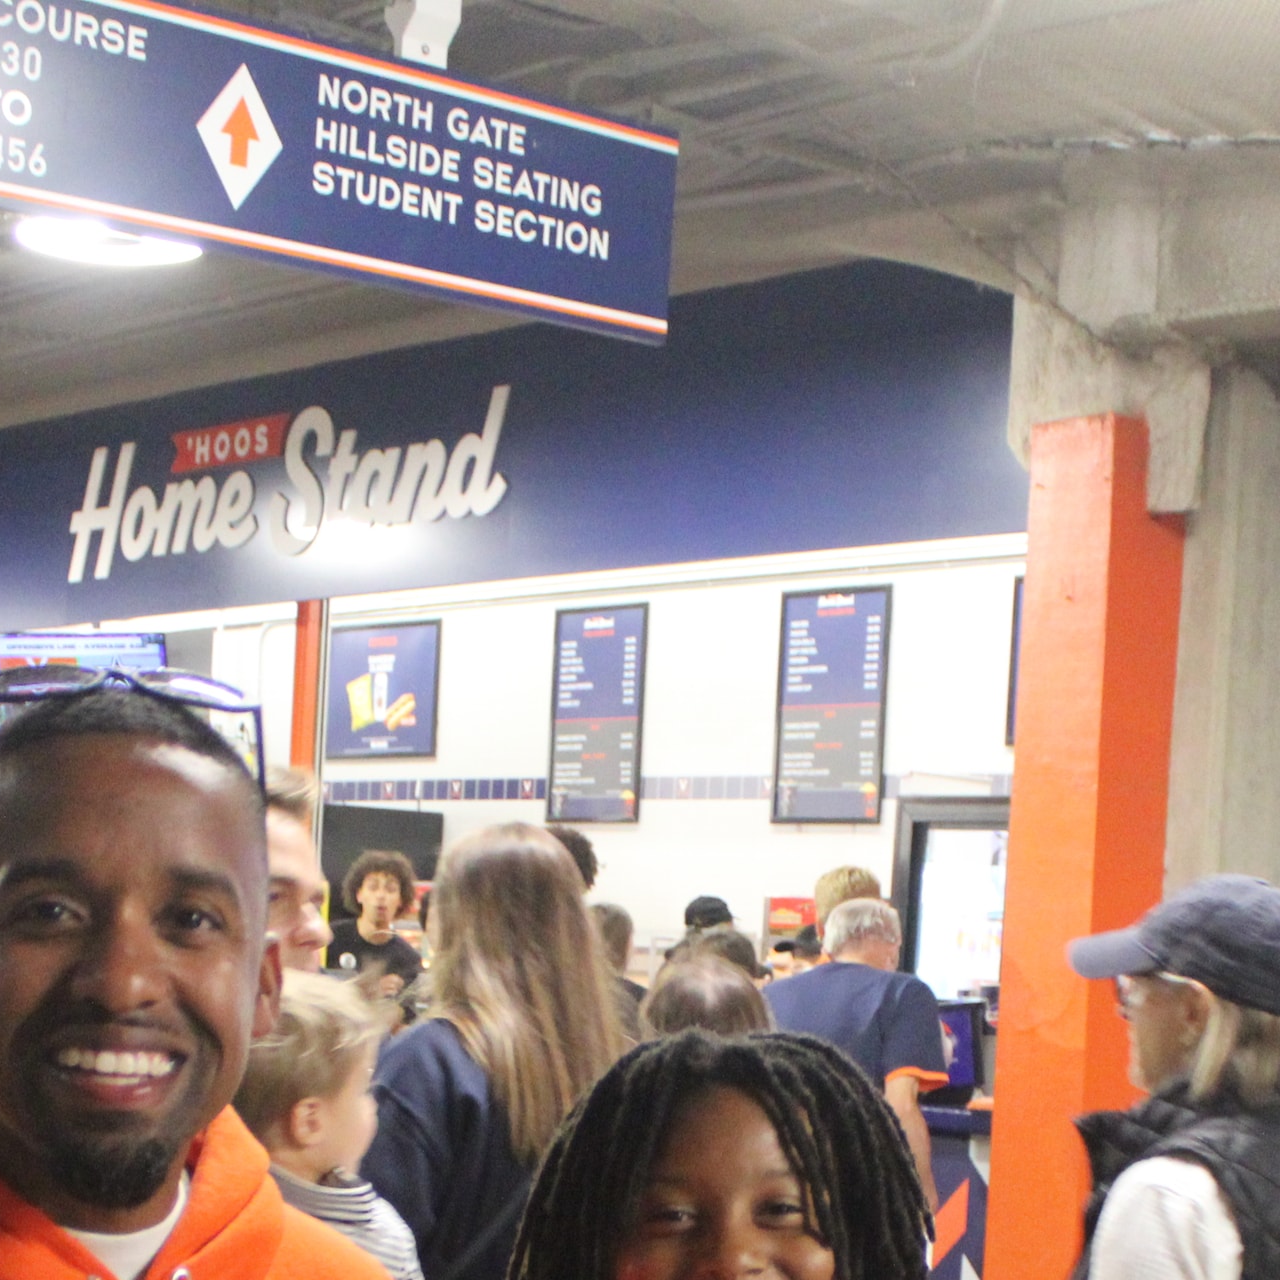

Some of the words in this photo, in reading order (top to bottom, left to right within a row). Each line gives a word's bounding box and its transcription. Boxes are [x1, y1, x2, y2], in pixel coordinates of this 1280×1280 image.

[318, 74, 433, 132] NORTH
[447, 107, 526, 156] GATE
[312, 161, 463, 225] STUDENT
[474, 200, 609, 260] SECTION
[315, 117, 461, 182] HILLSIDE
[473, 157, 601, 217] SEATING
[67, 441, 258, 583] Home
[269, 384, 511, 557] Stand
[187, 424, 268, 464] 'HOOS
